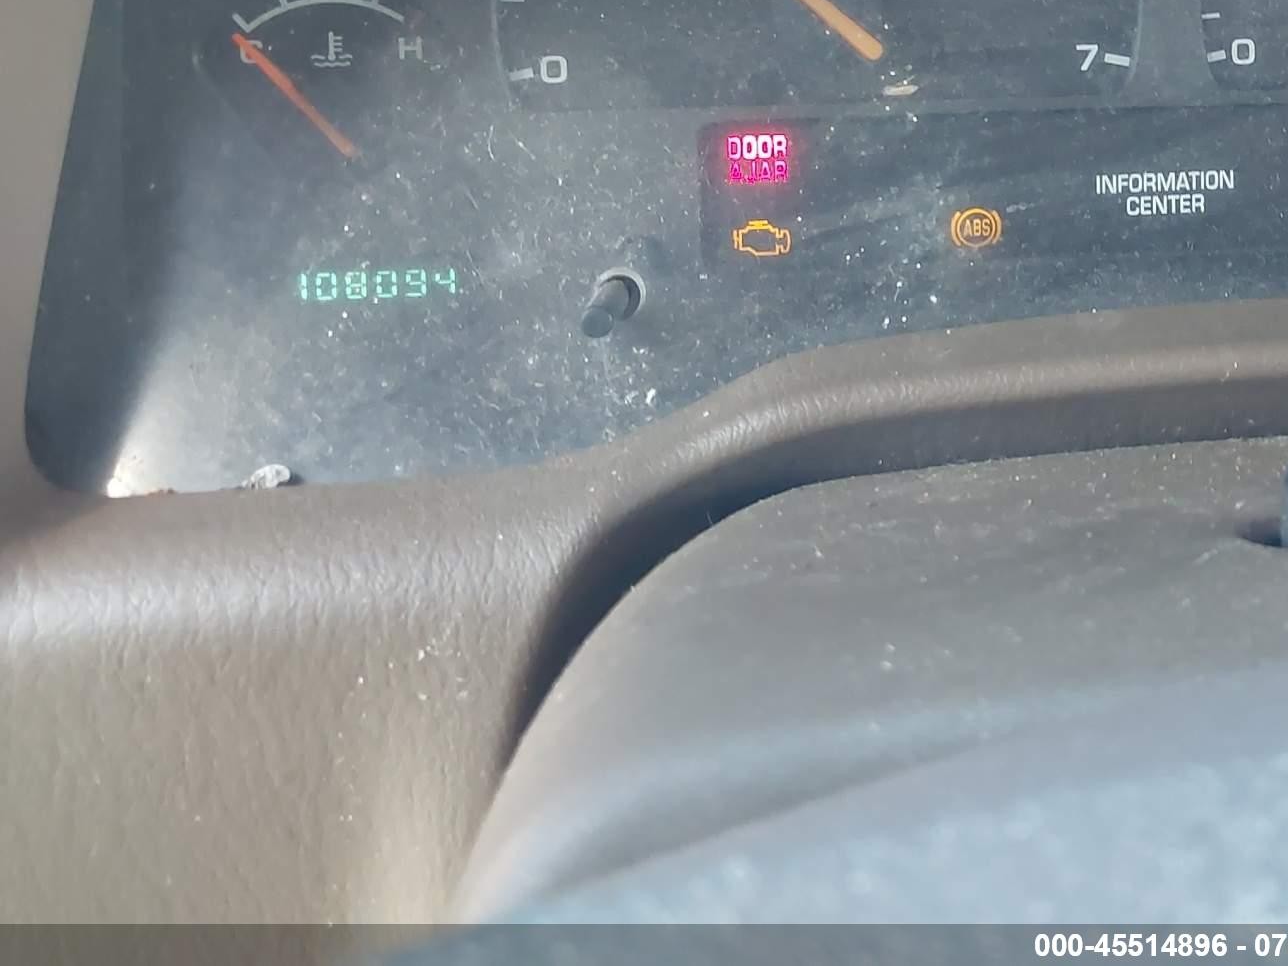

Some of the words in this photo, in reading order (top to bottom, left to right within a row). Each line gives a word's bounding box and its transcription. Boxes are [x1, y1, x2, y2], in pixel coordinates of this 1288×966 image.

[400, 38, 423, 59] H
[1074, 42, 1101, 73] 7
[1231, 40, 1256, 65] 0
[540, 56, 567, 83] 0
[726, 133, 788, 161] DOOR
[1095, 169, 1236, 196] INFORMATION
[1125, 193, 1206, 218] CENTER
[963, 218, 991, 237] ABS
[300, 268, 456, 300] 108094
